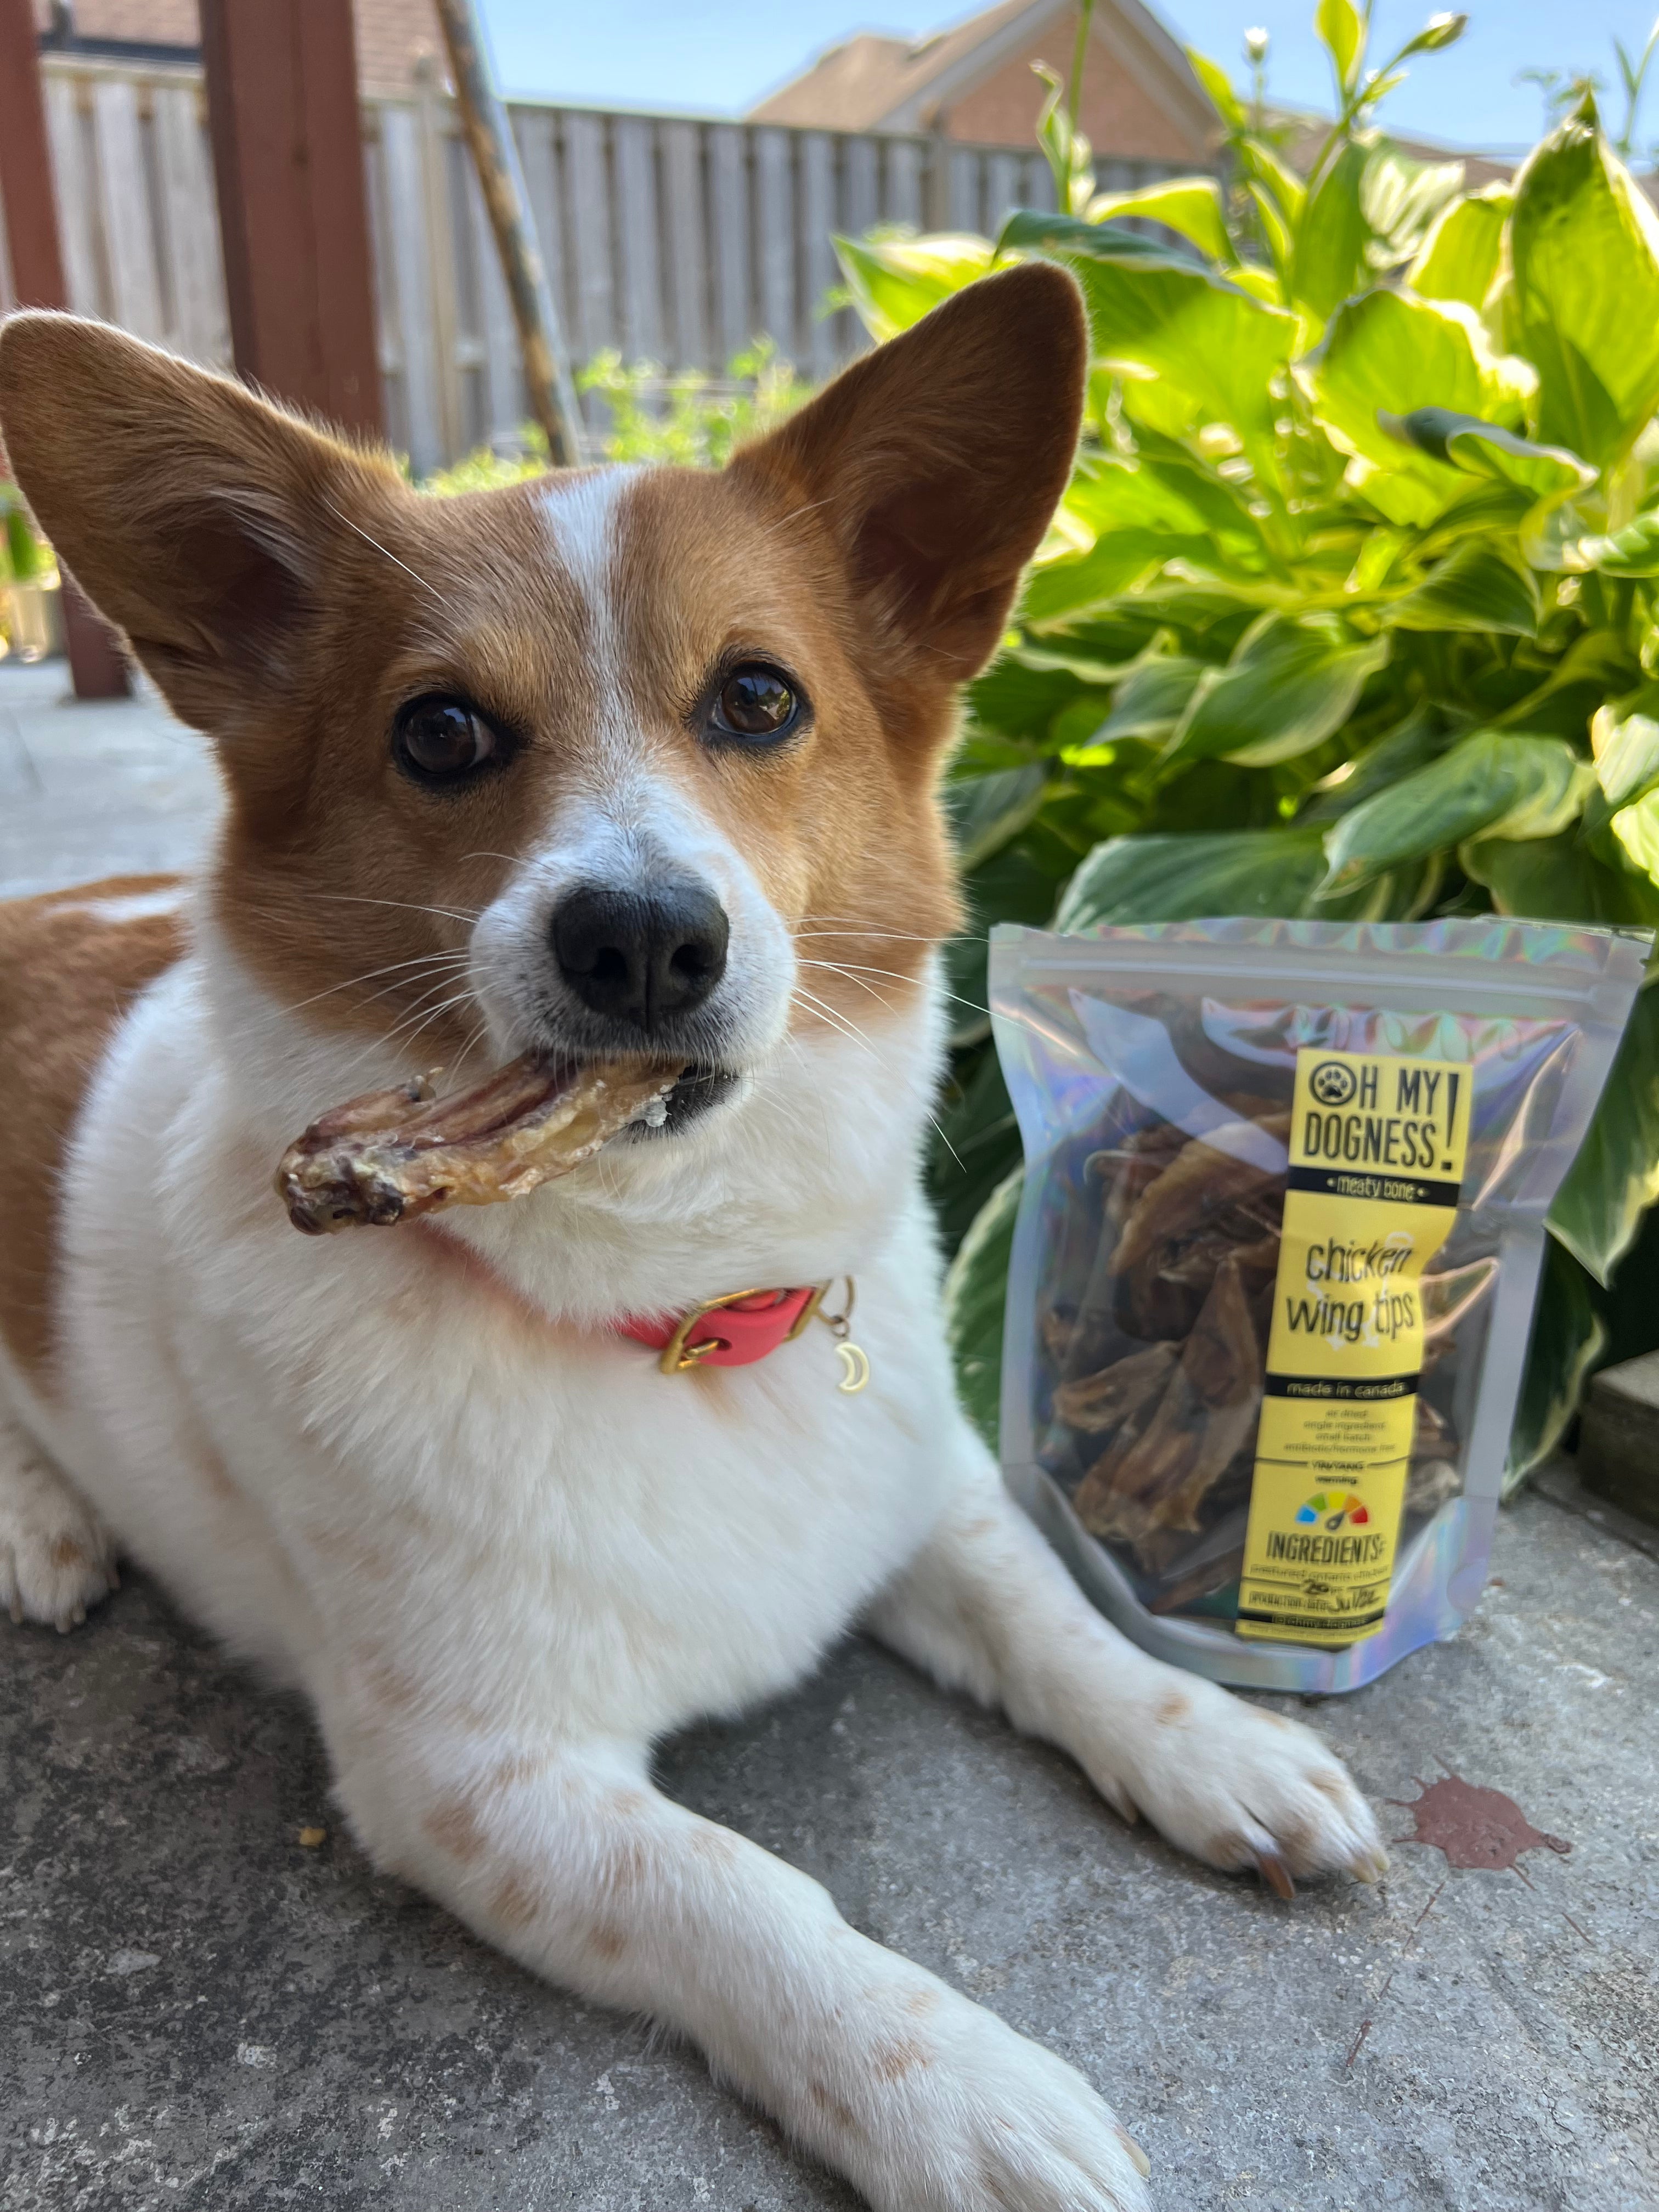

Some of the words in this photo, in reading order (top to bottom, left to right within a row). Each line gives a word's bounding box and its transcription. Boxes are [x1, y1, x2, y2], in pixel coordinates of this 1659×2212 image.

[1309, 1062, 1378, 1108] OH
[1397, 1068, 1441, 1115] MY
[1338, 1175, 1382, 1198] meaty
[1384, 1178, 1415, 1201] bone
[1306, 1237, 1413, 1283] chicken
[1286, 1293, 1364, 1342] wing
[1373, 1290, 1414, 1341] tips
[1287, 1380, 1333, 1397] made
[1336, 1381, 1351, 1397] in
[1355, 1379, 1408, 1398] canada
